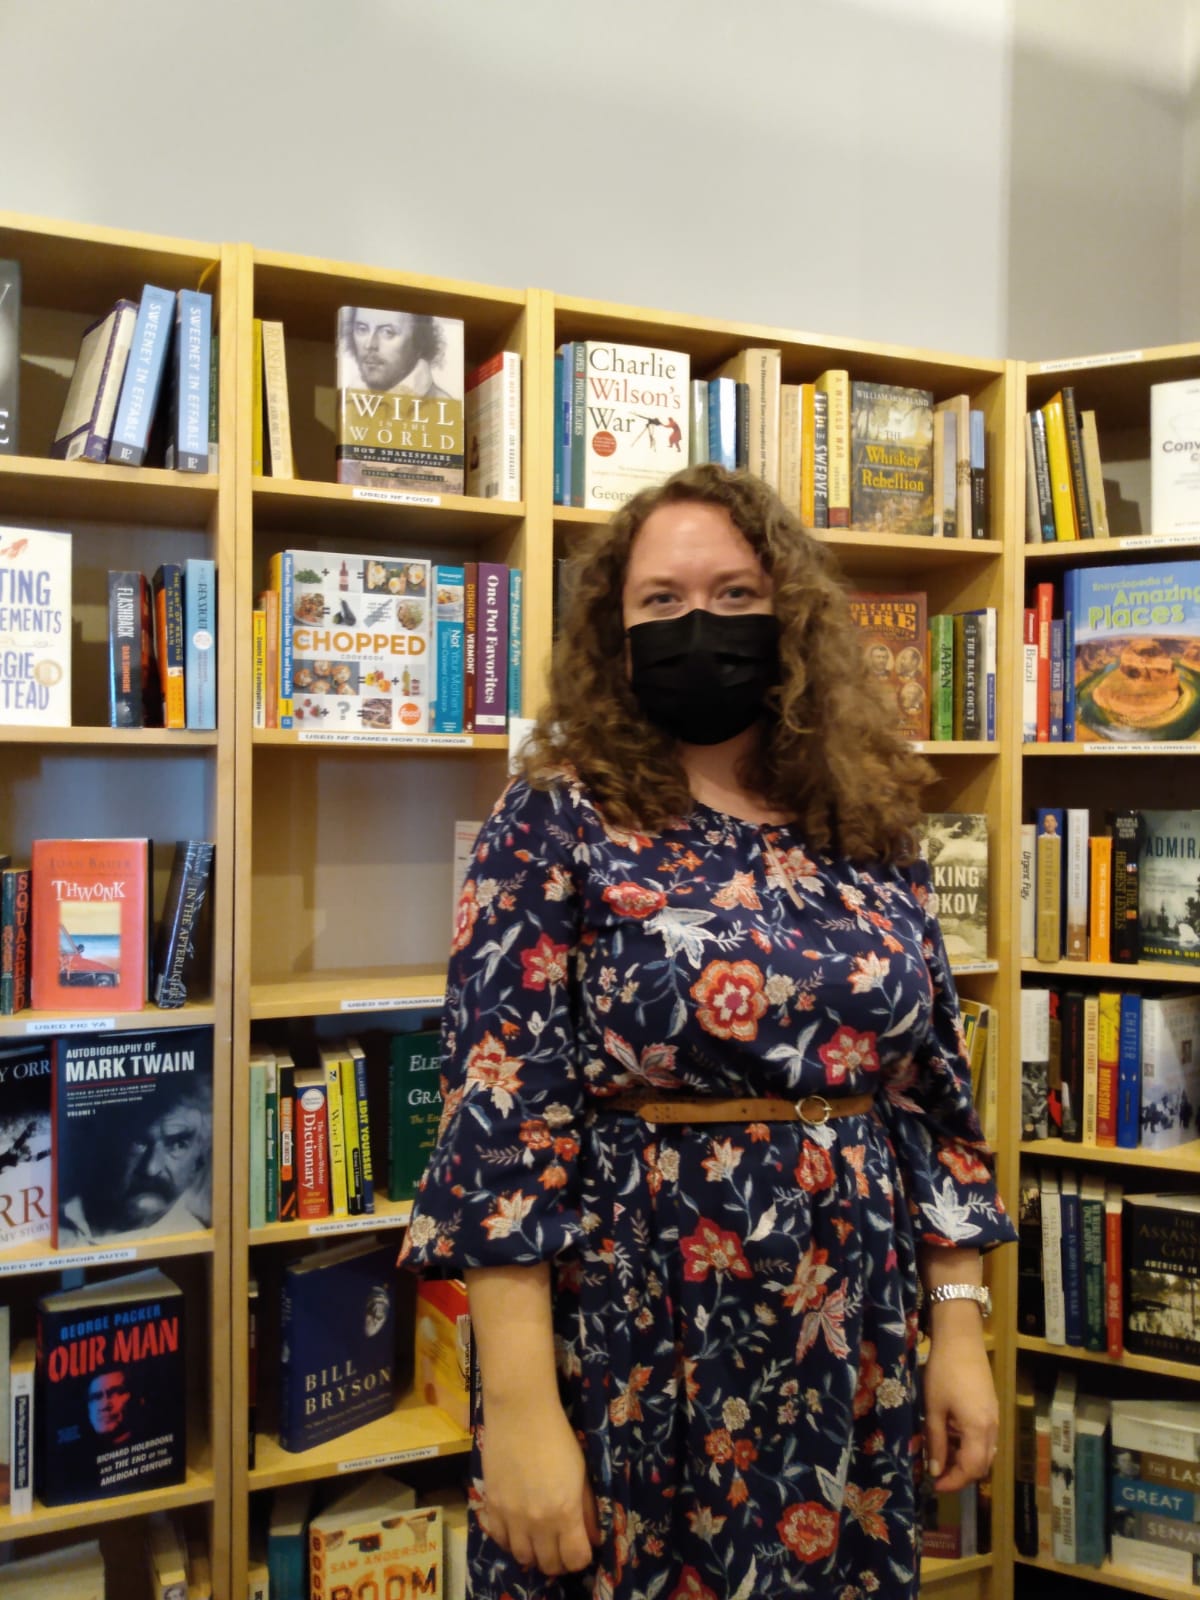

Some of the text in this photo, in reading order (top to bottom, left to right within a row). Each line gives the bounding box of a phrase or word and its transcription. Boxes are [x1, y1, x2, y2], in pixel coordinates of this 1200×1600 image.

[123, 303, 162, 442] SWEENEY IN EFFABLE
[575, 346, 584, 372] COOPER
[589, 347, 676, 380] Charlie
[187, 307, 201, 449] SWEENEY IN EFFABLE
[589, 376, 681, 410] Wilson's
[350, 392, 455, 426] WILL
[856, 389, 888, 402] WILLIAM
[587, 406, 635, 433] War
[349, 425, 455, 450] WORLD
[381, 449, 452, 461] SHAKESPEARE
[865, 445, 921, 472] Whiskey
[815, 444, 827, 499] SWERVE
[862, 469, 924, 491] Rebellion
[360, 491, 387, 499] USED
[0, 569, 51, 606] TING
[1092, 574, 1175, 592] Encyclopedia of
[1113, 583, 1200, 608] Amazing
[0, 609, 63, 634] EMENTS
[117, 587, 134, 638] FLASHBACK
[1088, 604, 1185, 630] Places
[293, 629, 427, 656] CHOPPED
[451, 630, 461, 648] Not
[466, 584, 475, 674] DISHING UP VERMONT
[485, 575, 499, 704] One Pot Favorites
[0, 651, 35, 680] GIE
[941, 643, 952, 689] JAPAN
[966, 637, 976, 722] THE BLACK COUNT
[1026, 648, 1035, 683] Brazil
[1053, 661, 1062, 689] PARIS
[1145, 836, 1200, 859] ADMIR
[51, 880, 126, 901] THWONK
[934, 866, 979, 888] KING
[1021, 850, 1031, 901] Urgent Fury
[14, 874, 28, 1011] SQUASHED
[168, 887, 197, 1000] IN THE AFTERLIGHT
[66, 1041, 157, 1059] AUTOBIOGRAPHY OF
[1124, 1011, 1137, 1060] CHATTER
[13, 1059, 51, 1080] ORR
[65, 1050, 195, 1083] MARK TWAIN
[1099, 1068, 1111, 1119] MONSOON
[66, 1110, 91, 1118] VOLUME
[302, 1113, 316, 1190] Dictionary
[358, 1099, 373, 1181] EDIT YOURSELF
[60, 1304, 162, 1342] GEORGE PACKER
[48, 1317, 179, 1383] OUR MAN
[305, 1359, 358, 1393] BILL
[305, 1366, 392, 1417] BRYSON
[96, 1433, 174, 1465] RICHARD HOLBROOKE
[114, 1457, 130, 1470] THE
[131, 1452, 147, 1466] END
[100, 1457, 174, 1488] AMERICAN CENTURY
[1121, 1486, 1185, 1511] GREAT
[1147, 1522, 1200, 1545] SENA
[330, 1541, 437, 1574] SAM ANDERSON
